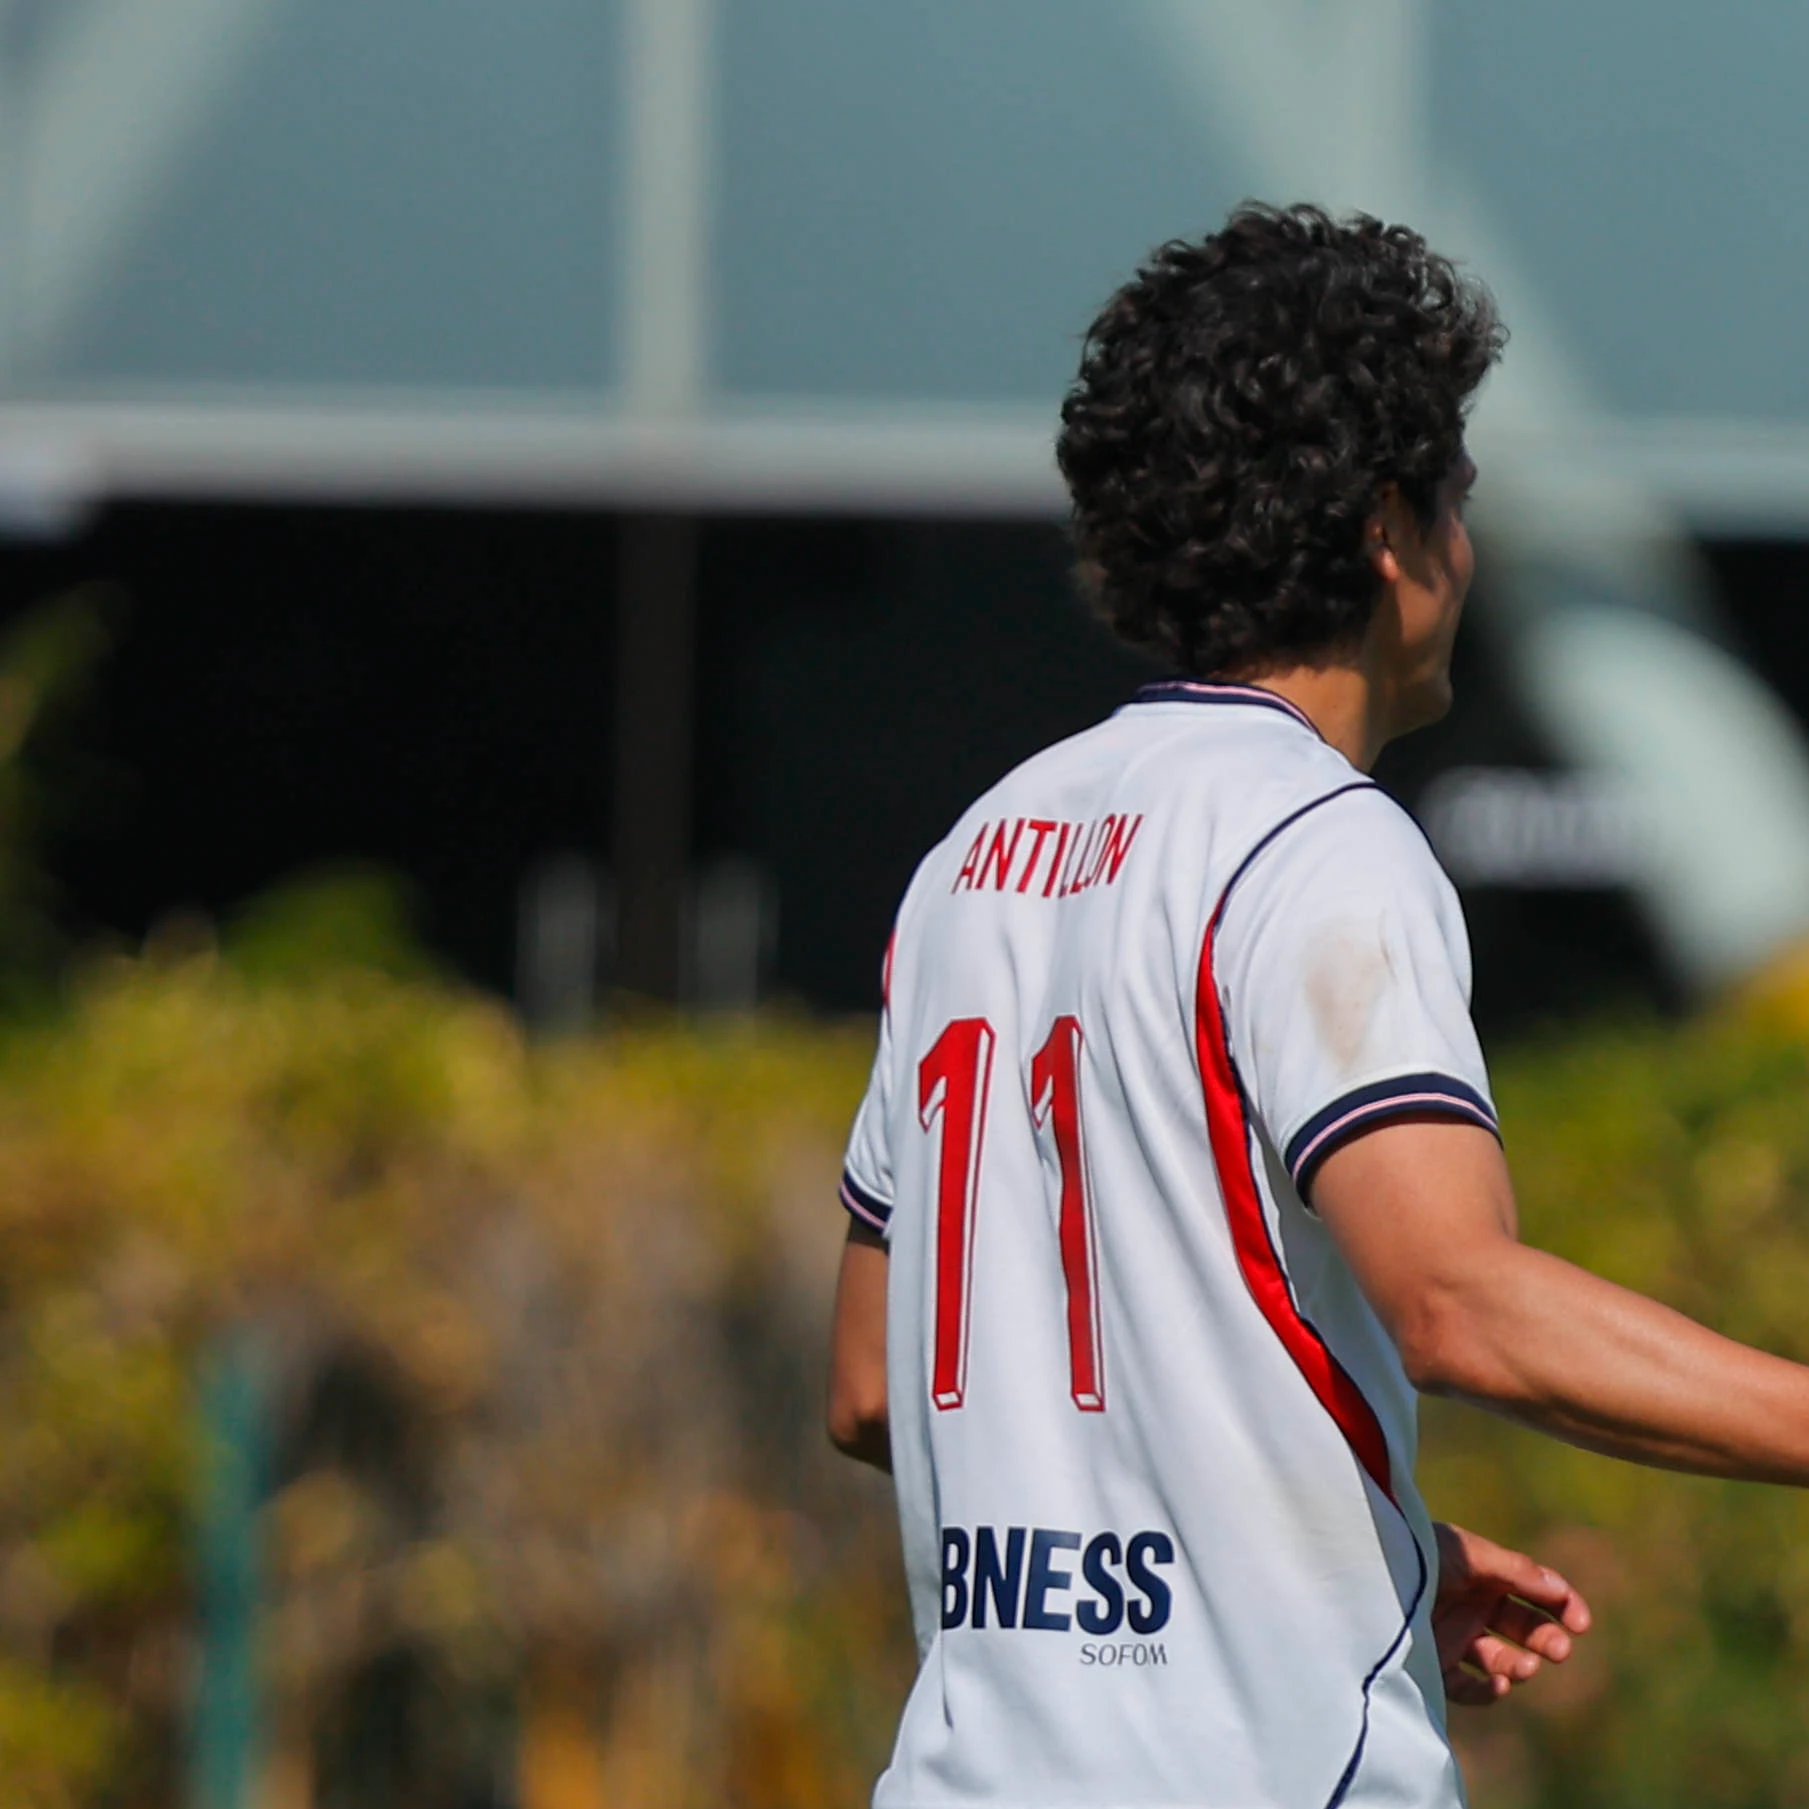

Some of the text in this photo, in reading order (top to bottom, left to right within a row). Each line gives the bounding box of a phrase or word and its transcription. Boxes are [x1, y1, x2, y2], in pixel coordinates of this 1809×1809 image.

[951, 813, 1143, 899] ANTILLON
[918, 1014, 1105, 1412] 11
[1079, 1642, 1169, 1667] SOFOM
